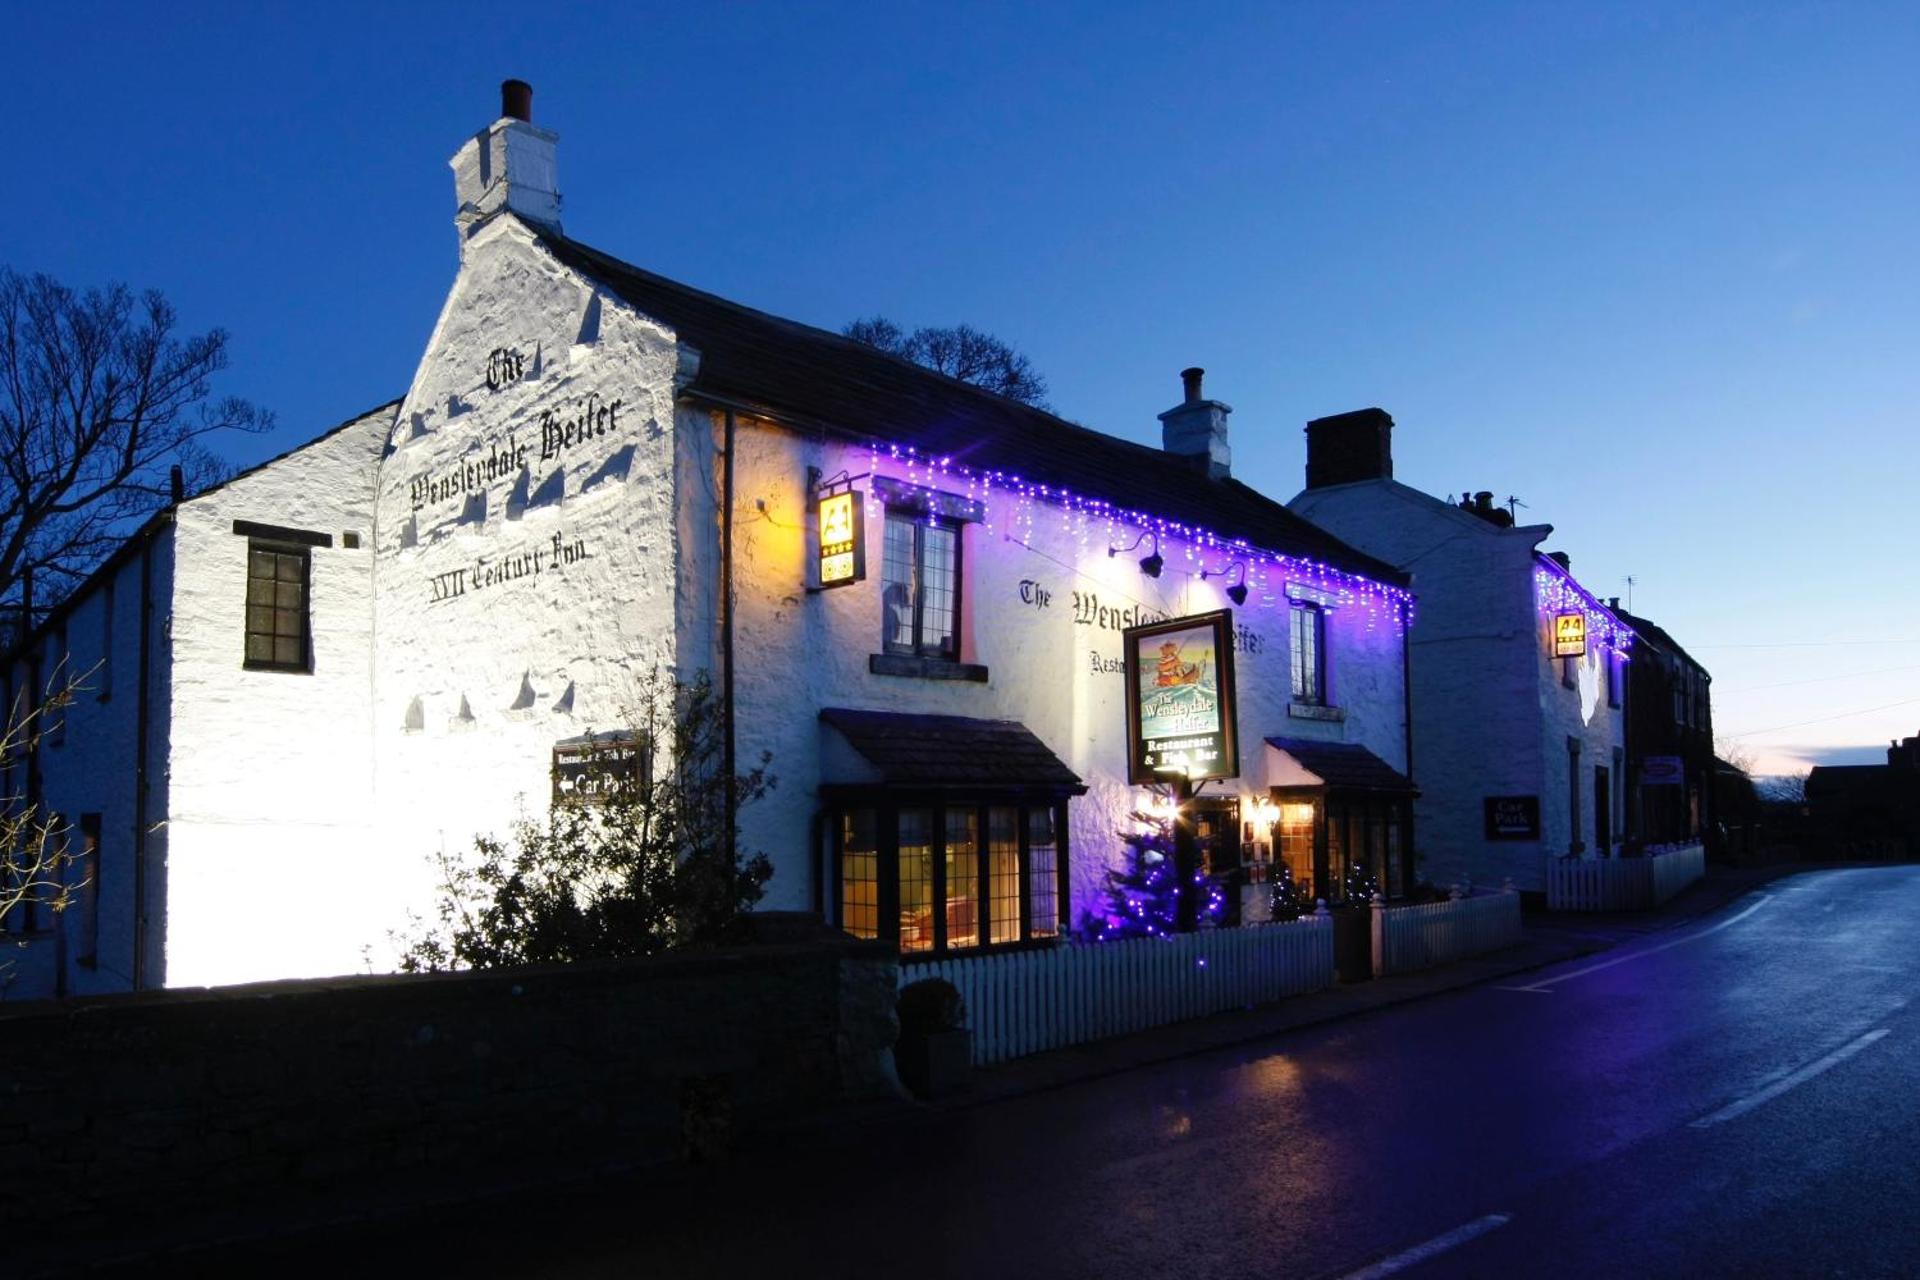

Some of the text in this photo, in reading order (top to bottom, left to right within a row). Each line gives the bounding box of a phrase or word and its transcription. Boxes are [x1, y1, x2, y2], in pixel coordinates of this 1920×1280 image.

[486, 348, 525, 390] The
[411, 393, 622, 511] Wensleydale Heifer
[430, 531, 587, 603] XVII Century Inn
[1018, 579, 1052, 610] The
[1145, 697, 1214, 718] Wensleydale
[1144, 755, 1154, 765] &
[1195, 748, 1218, 761] Bar
[1147, 737, 1214, 752] Restaurant
[576, 774, 599, 795] Car
